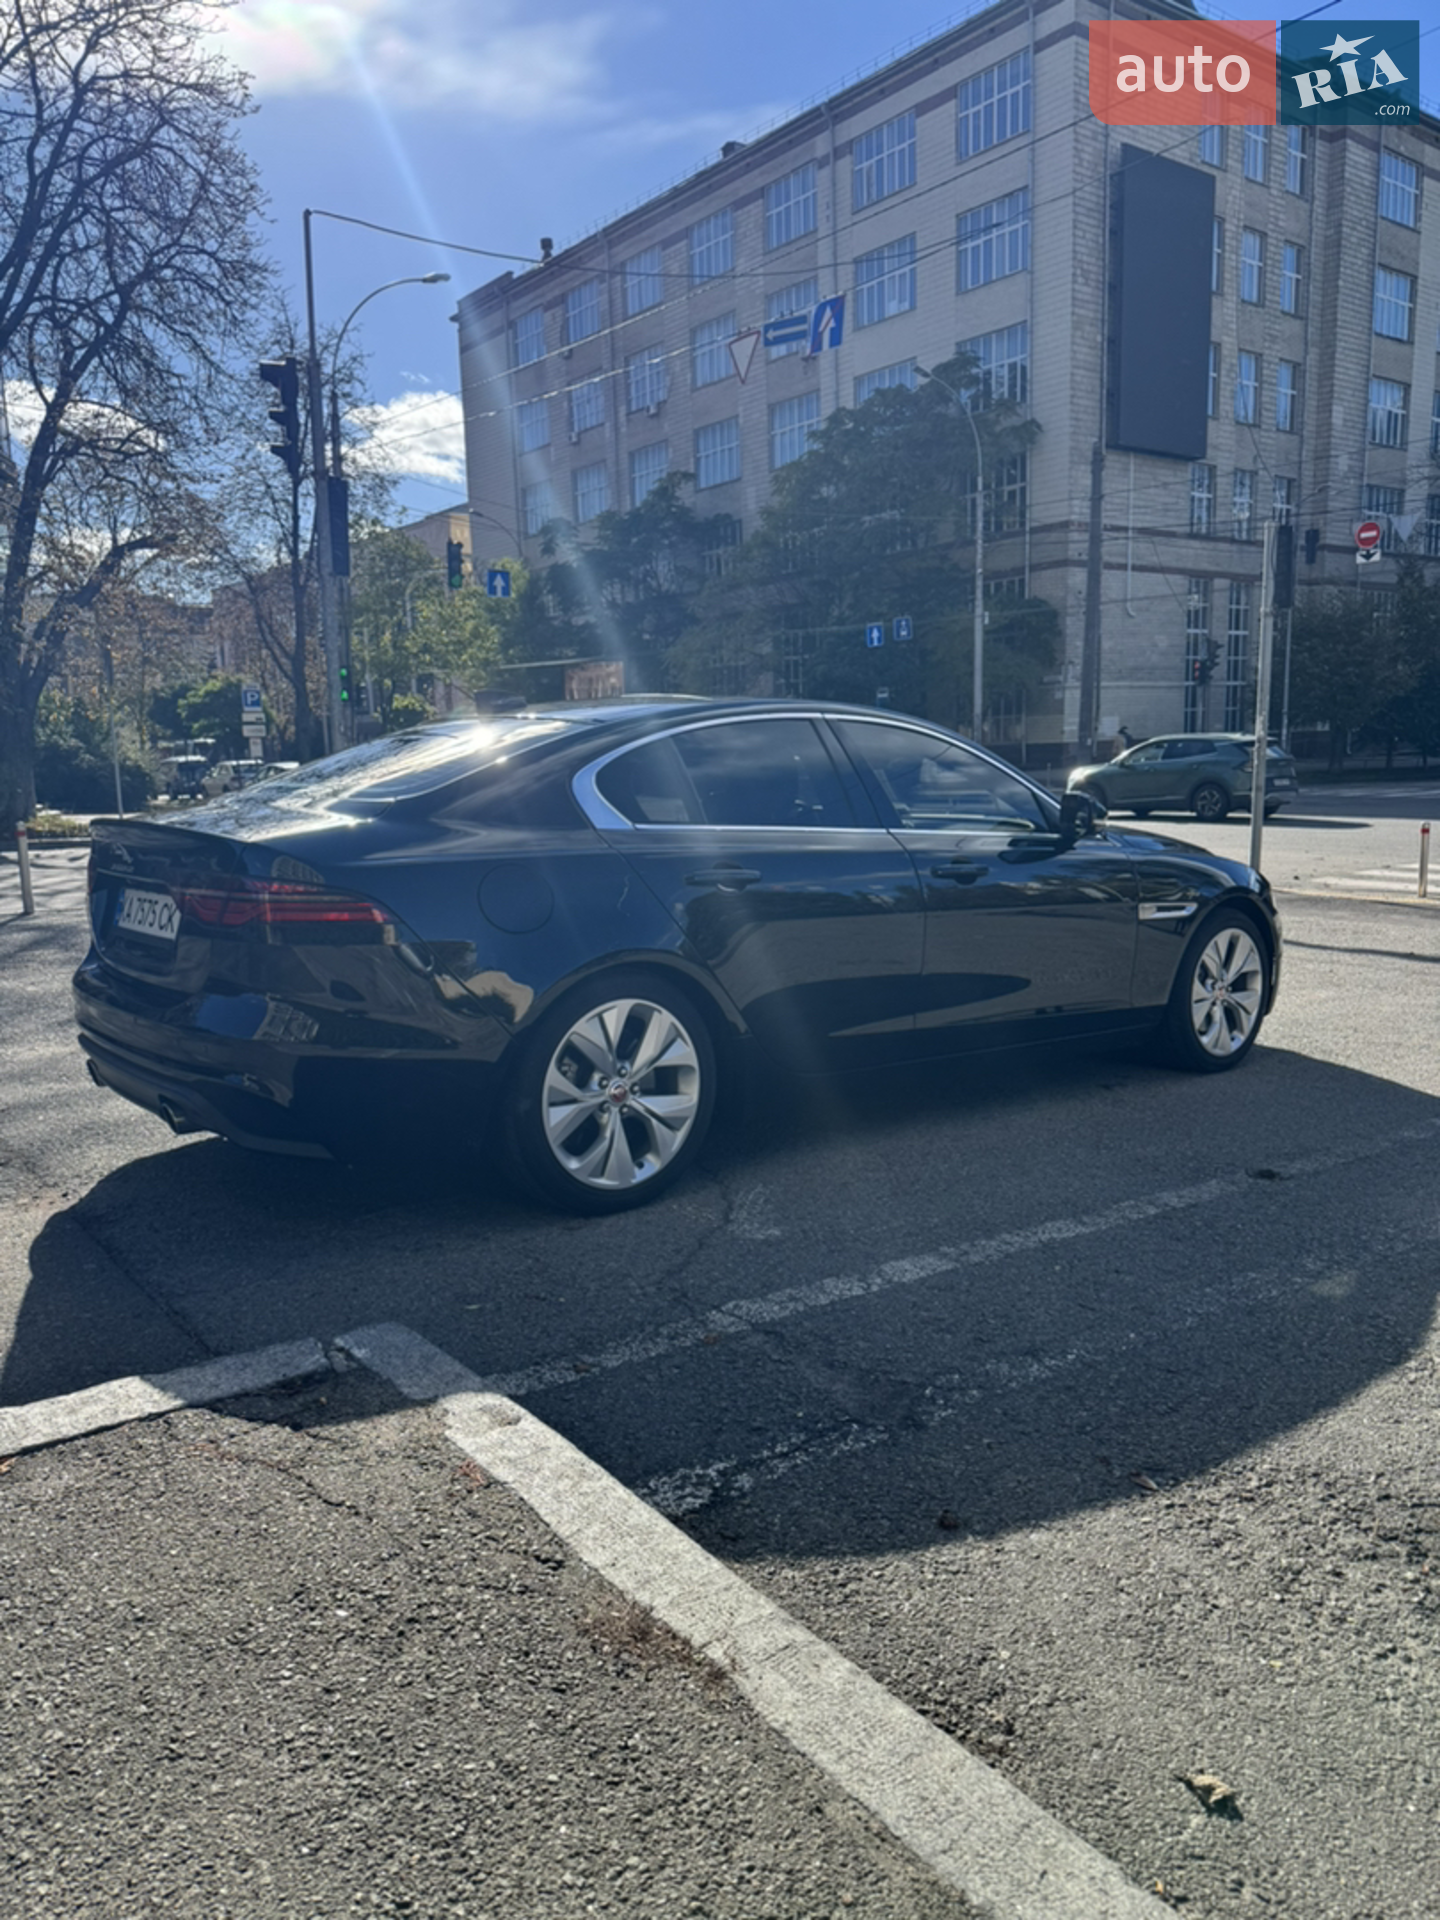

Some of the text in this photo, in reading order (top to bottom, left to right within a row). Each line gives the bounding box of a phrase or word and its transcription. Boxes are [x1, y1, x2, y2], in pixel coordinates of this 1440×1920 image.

[246, 691, 260, 705] P
[132, 897, 159, 928] 7575
[157, 902, 178, 934] CK
